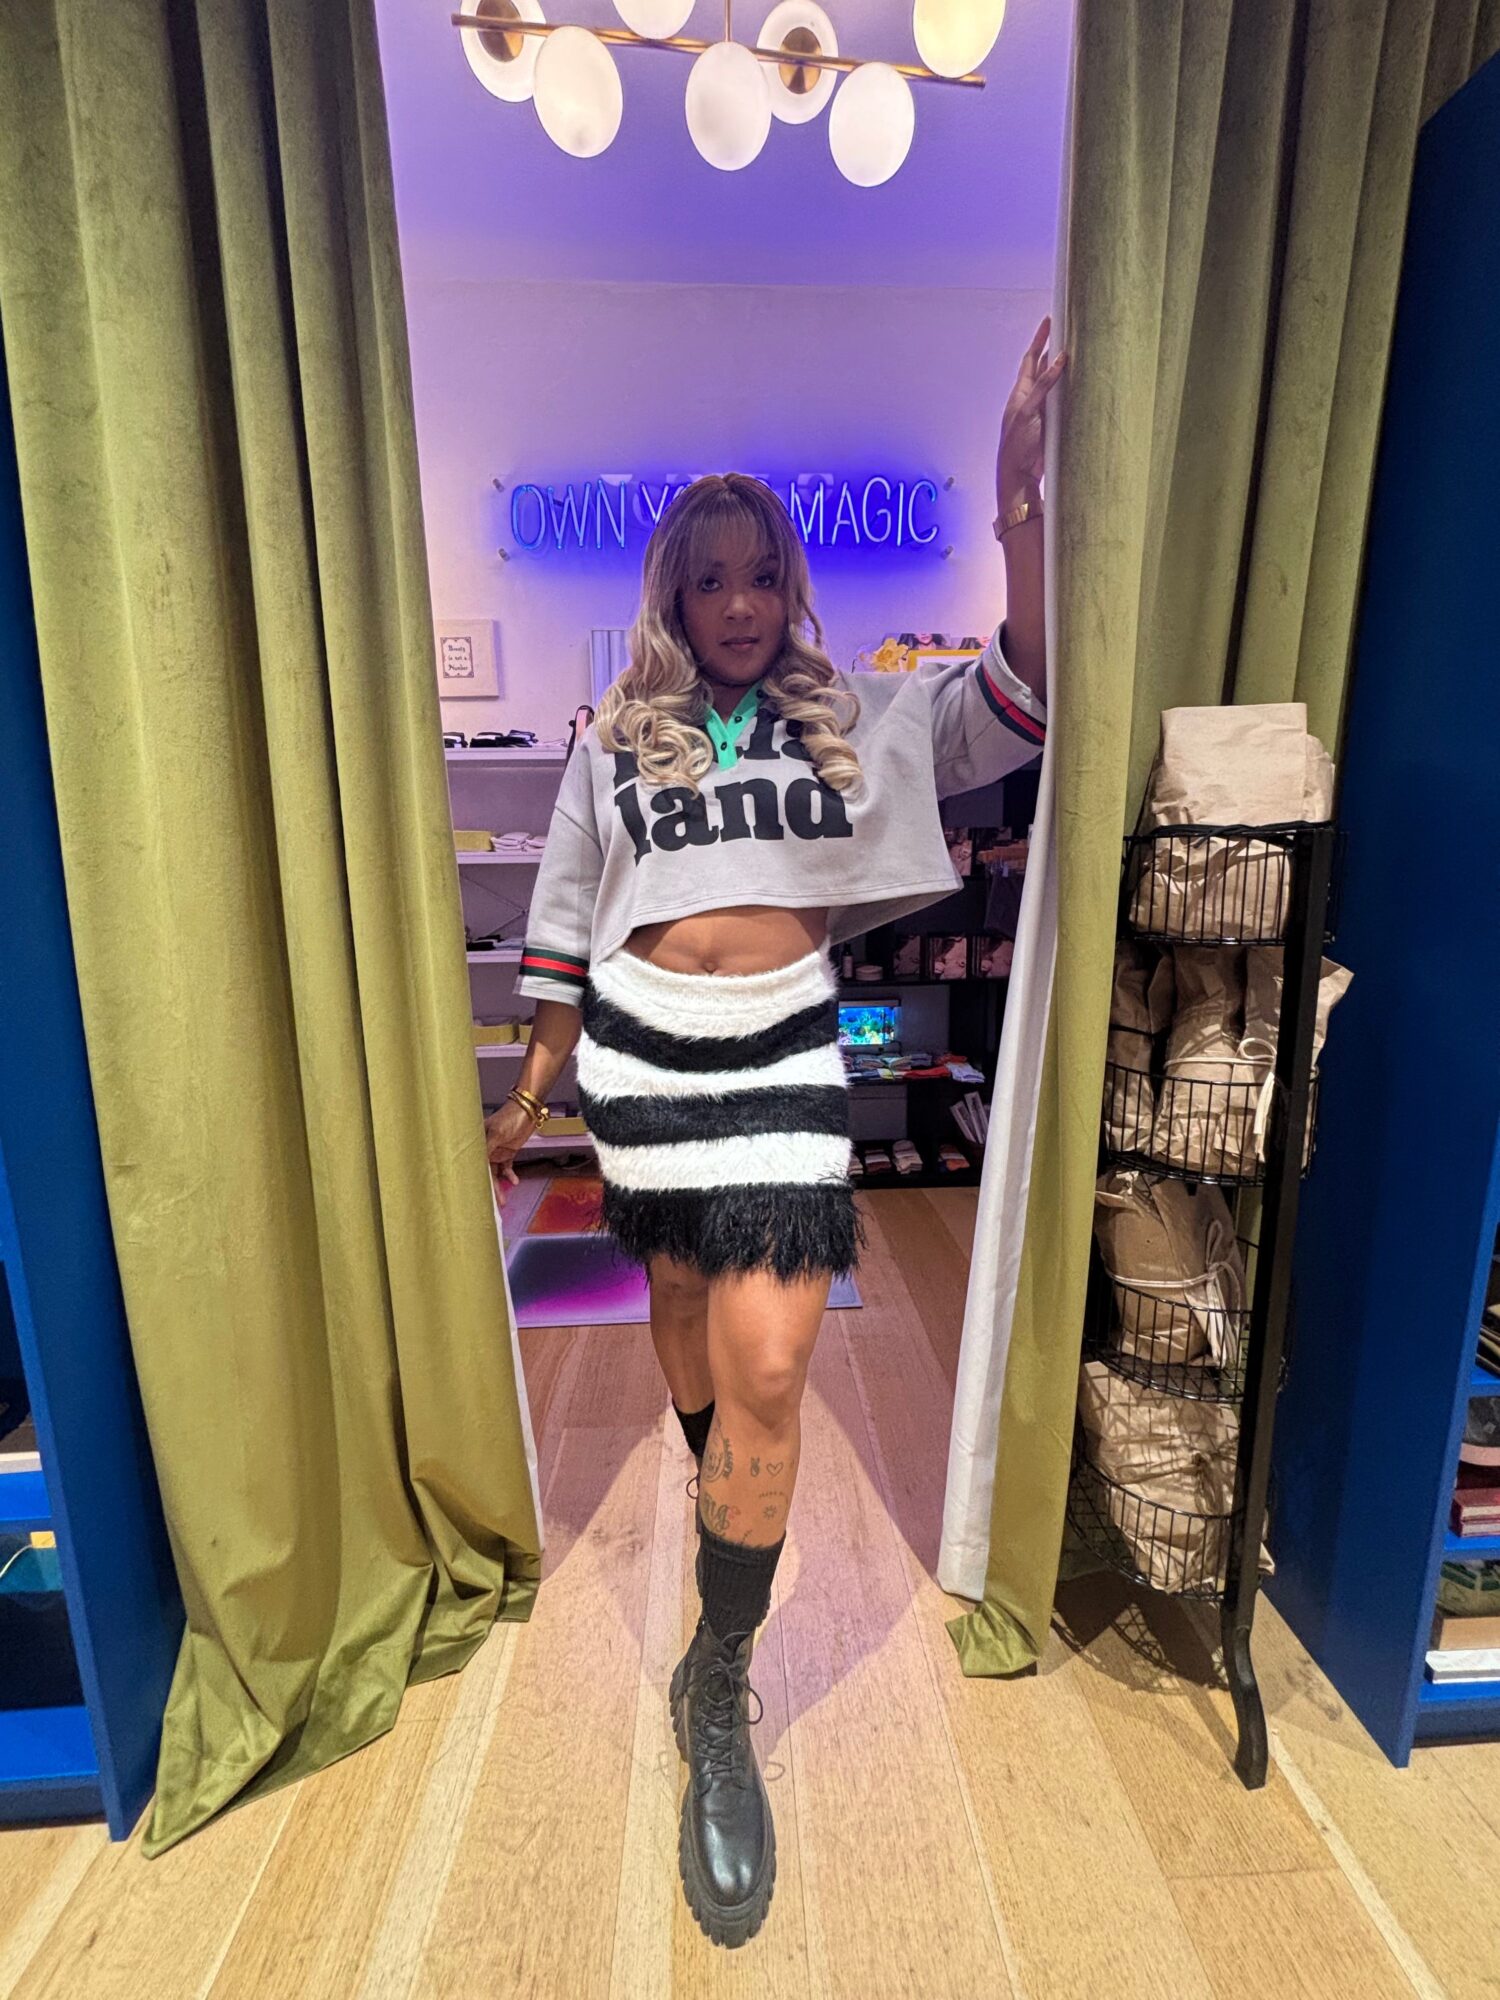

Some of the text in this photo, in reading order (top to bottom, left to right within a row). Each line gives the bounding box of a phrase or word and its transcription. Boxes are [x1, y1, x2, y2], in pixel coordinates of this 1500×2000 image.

[510, 478, 626, 550] OWN
[789, 476, 939, 547] MAGIC
[614, 766, 853, 868] land
